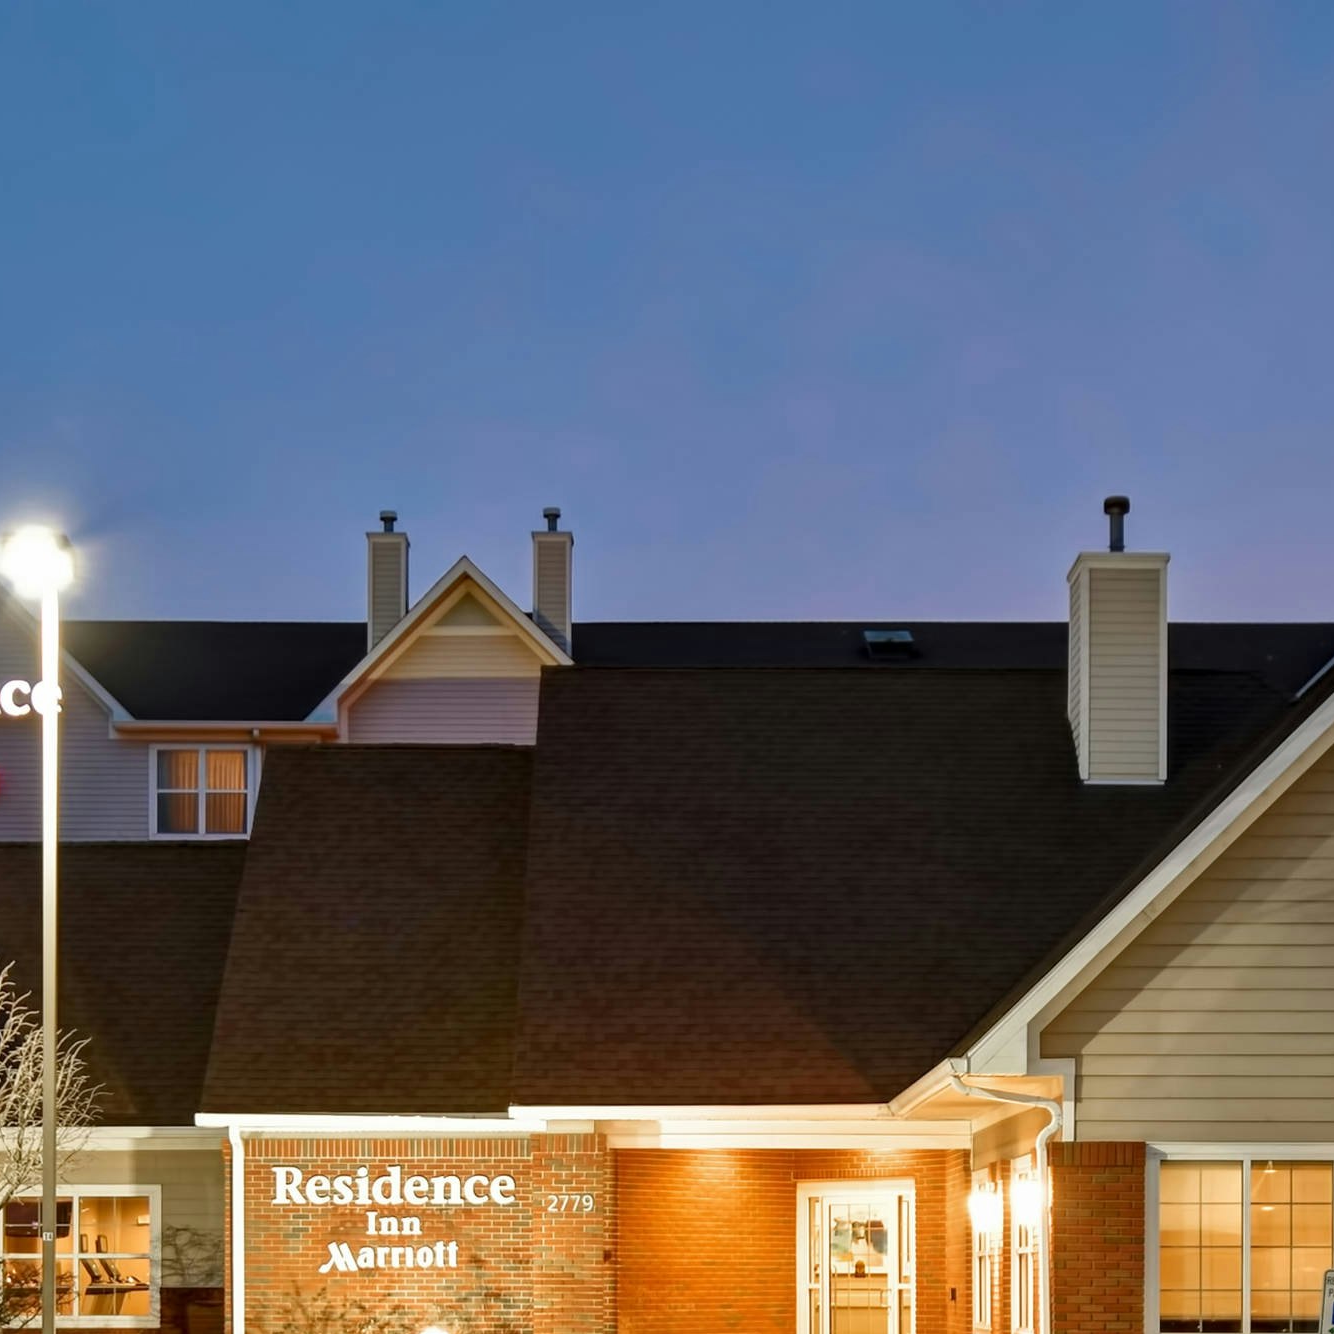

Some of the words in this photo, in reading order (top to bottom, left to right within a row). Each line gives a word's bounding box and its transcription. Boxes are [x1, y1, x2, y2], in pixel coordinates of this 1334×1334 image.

[271, 1165, 516, 1206] Residence
[547, 1194, 594, 1212] 2779
[365, 1211, 422, 1236] Inn
[318, 1241, 459, 1273] Marriott
